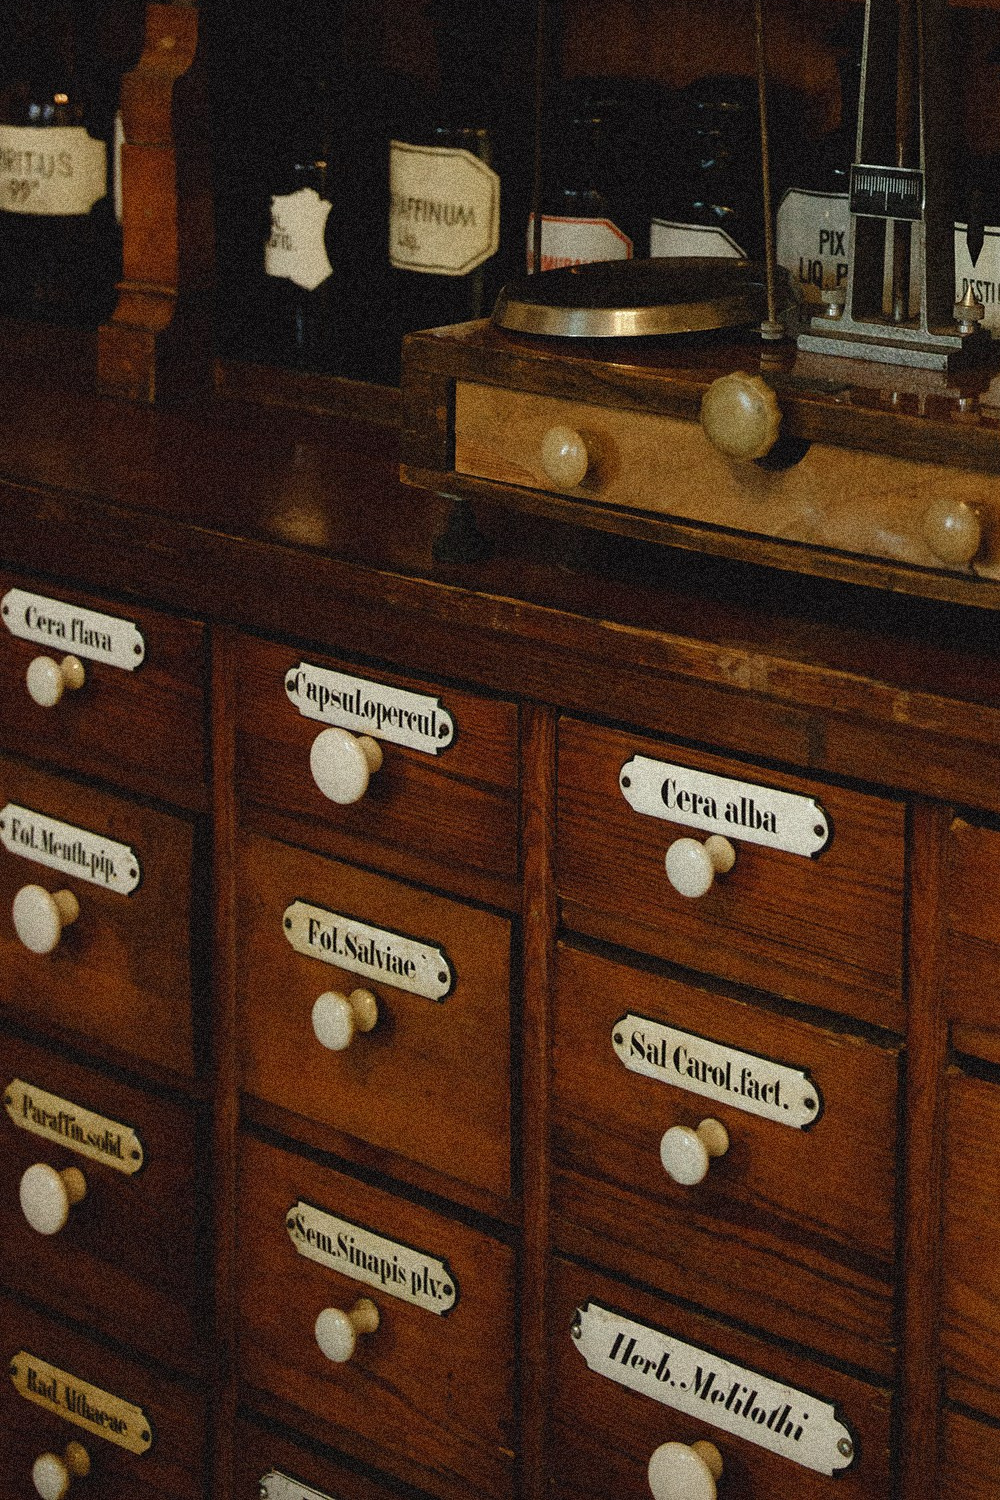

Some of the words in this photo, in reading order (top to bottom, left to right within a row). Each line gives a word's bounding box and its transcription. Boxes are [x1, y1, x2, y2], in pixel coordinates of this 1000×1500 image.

[819, 228, 846, 257] PIX
[25, 605, 66, 639] Cera
[70, 618, 113, 653] flava
[661, 777, 717, 821] Cera
[724, 795, 777, 834] alba
[629, 1030, 667, 1068] Sal
